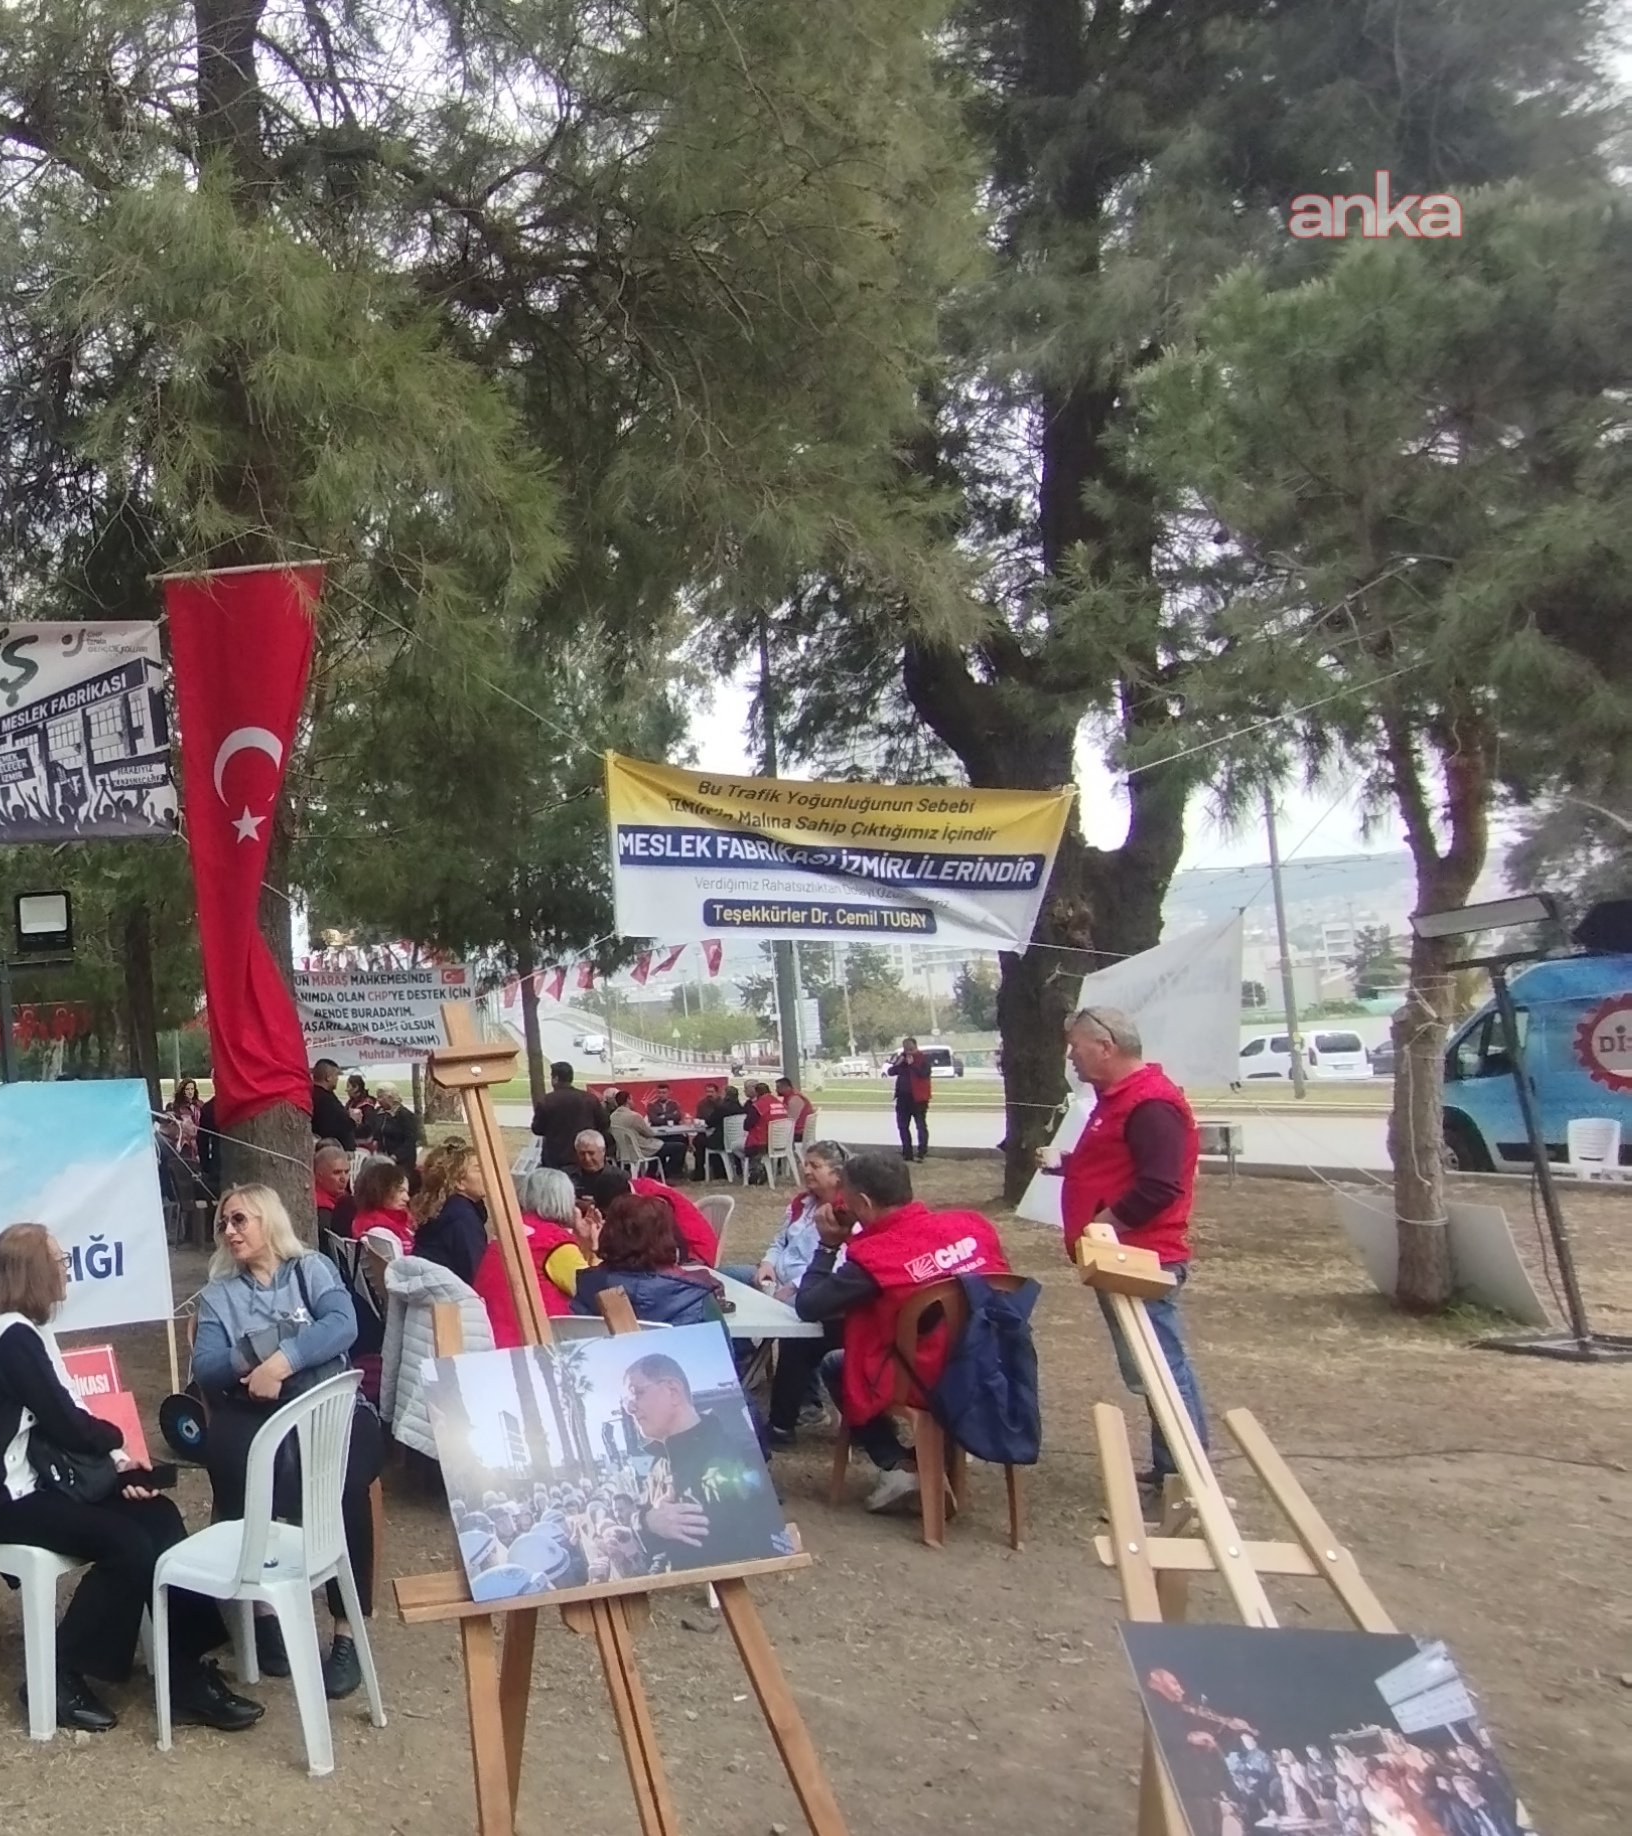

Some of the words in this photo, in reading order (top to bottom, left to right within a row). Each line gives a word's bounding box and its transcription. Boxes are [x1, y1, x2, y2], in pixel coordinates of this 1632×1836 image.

[1, 703, 48, 732] MESLEK
[50, 672, 127, 718] FABRİKASI
[698, 781, 722, 795] Bu
[728, 784, 782, 803] Trafik
[786, 790, 912, 815] Yoğunluğunun
[917, 798, 975, 814] Sebebi
[738, 810, 791, 829] Malına
[795, 816, 846, 836] Sahip
[851, 821, 939, 842] Çıktığımız
[942, 822, 998, 843] İçindir
[618, 832, 711, 859] MESLEK
[839, 850, 1036, 884] İZMİRLİLERİNDİR
[695, 876, 759, 894] Verdiğimiz
[713, 905, 808, 925] Teşekkürler
[811, 908, 833, 924] Dr.
[836, 908, 878, 926] Cemil
[881, 910, 927, 928] TUGAY
[337, 991, 365, 1002] OLAN
[407, 988, 446, 1000] DESTEK
[449, 986, 471, 1000] İÇİN
[302, 1020, 369, 1033] AŞARILARIN
[935, 1236, 977, 1269] CHP
